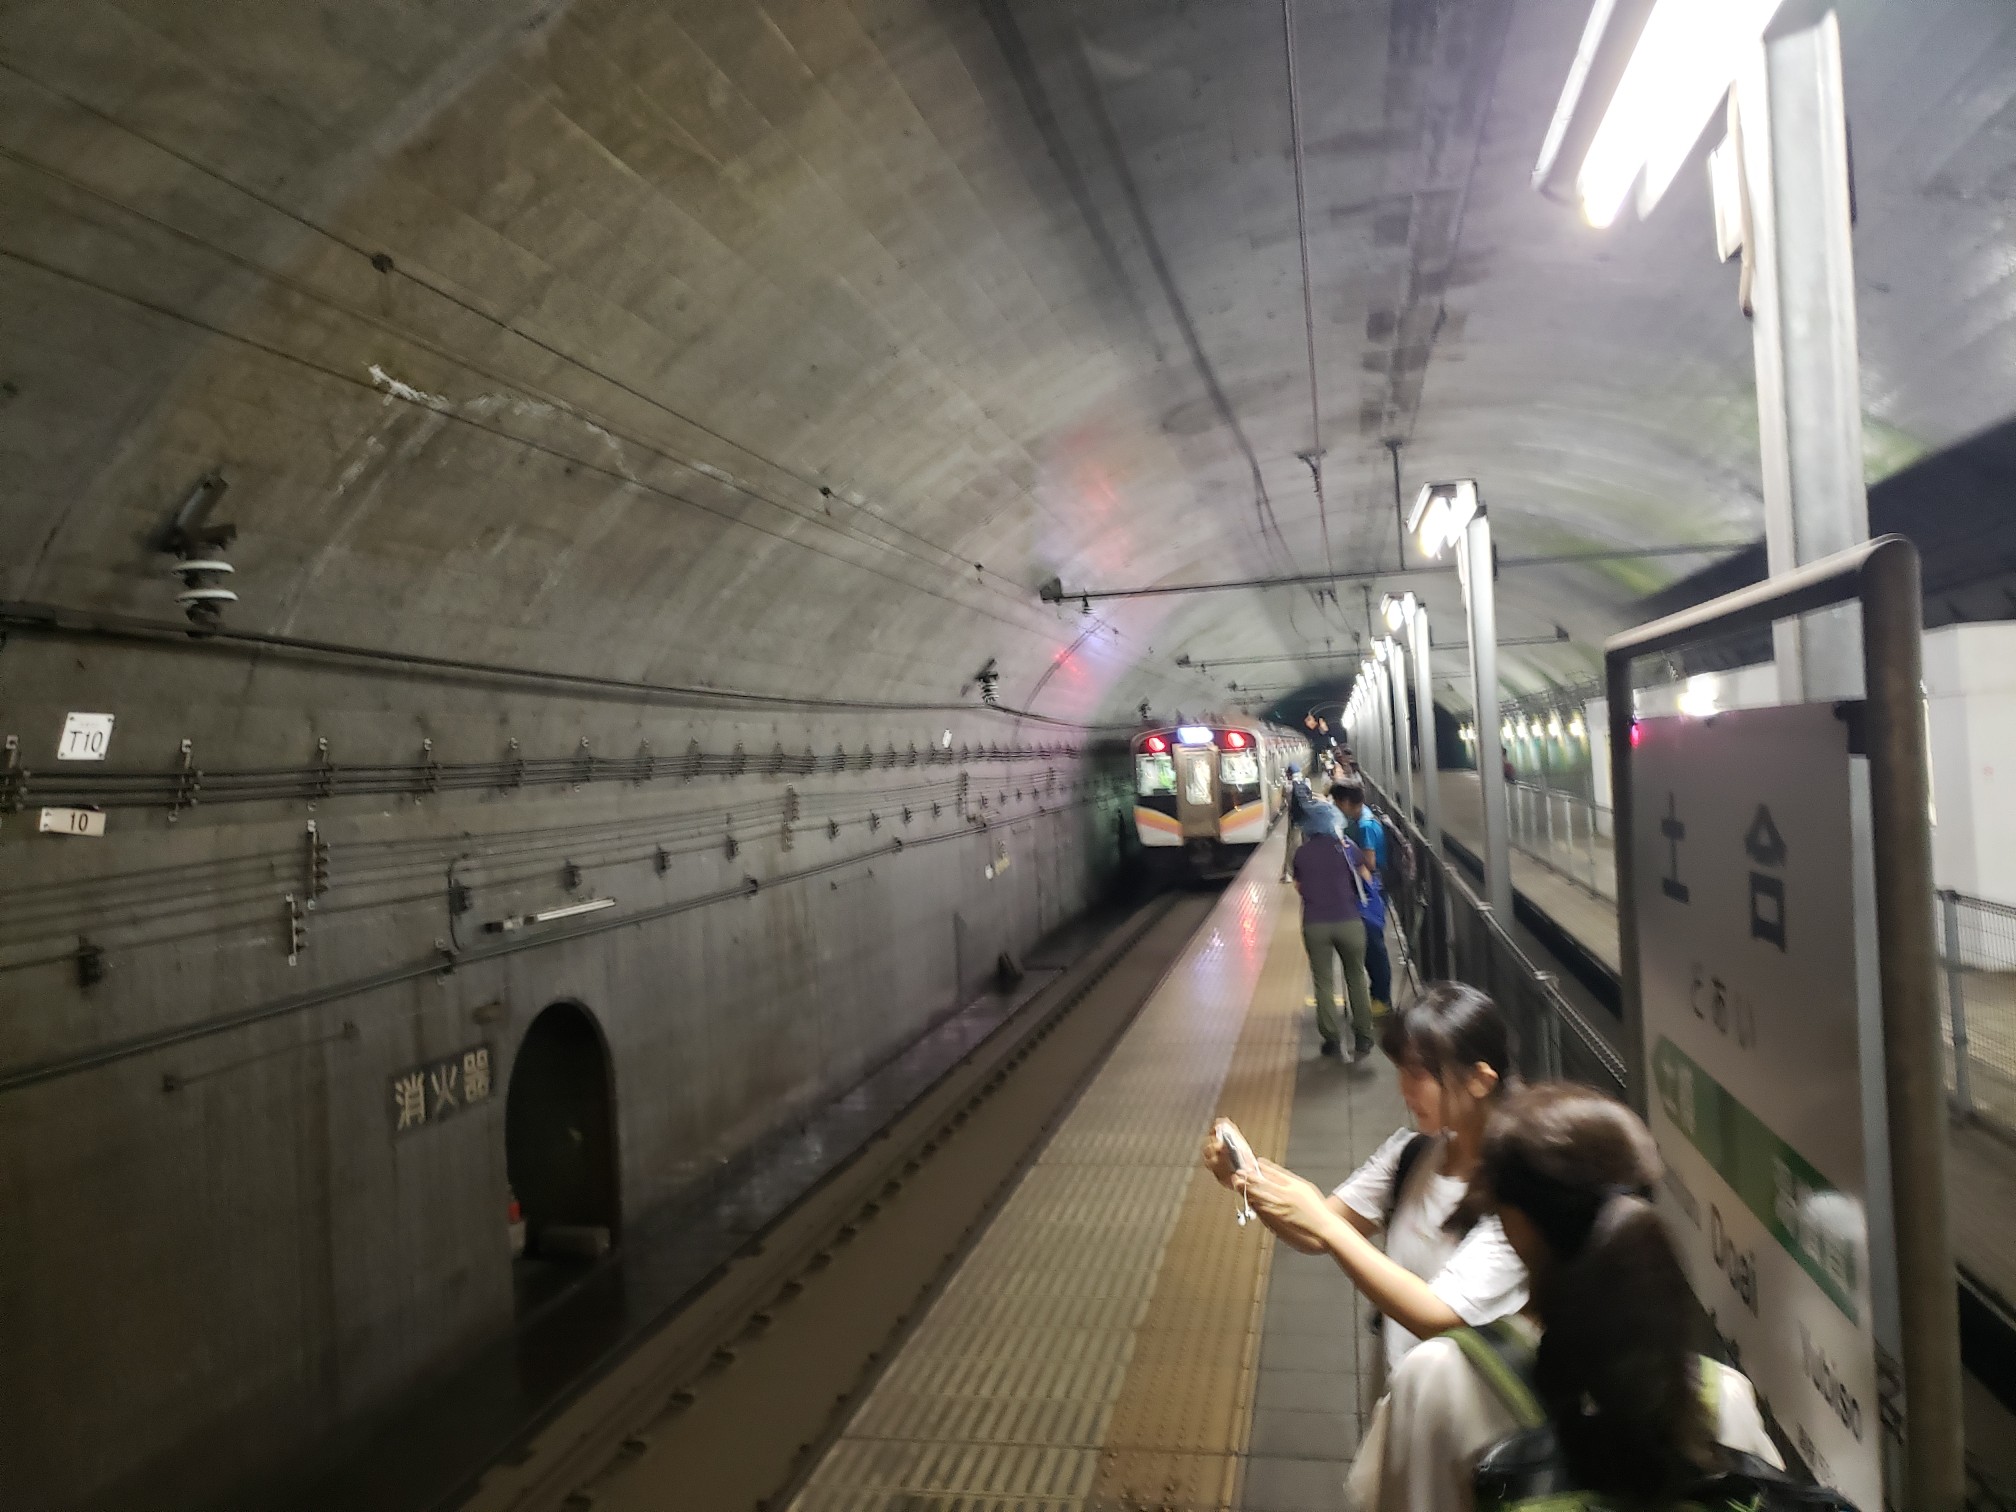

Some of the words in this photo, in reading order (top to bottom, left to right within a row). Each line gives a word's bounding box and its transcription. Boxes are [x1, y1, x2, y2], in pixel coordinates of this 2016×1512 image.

[70, 731, 104, 753] T10
[70, 813, 89, 832] 10
[1661, 790, 1789, 954] 土合
[394, 1047, 490, 1132] 消火器
